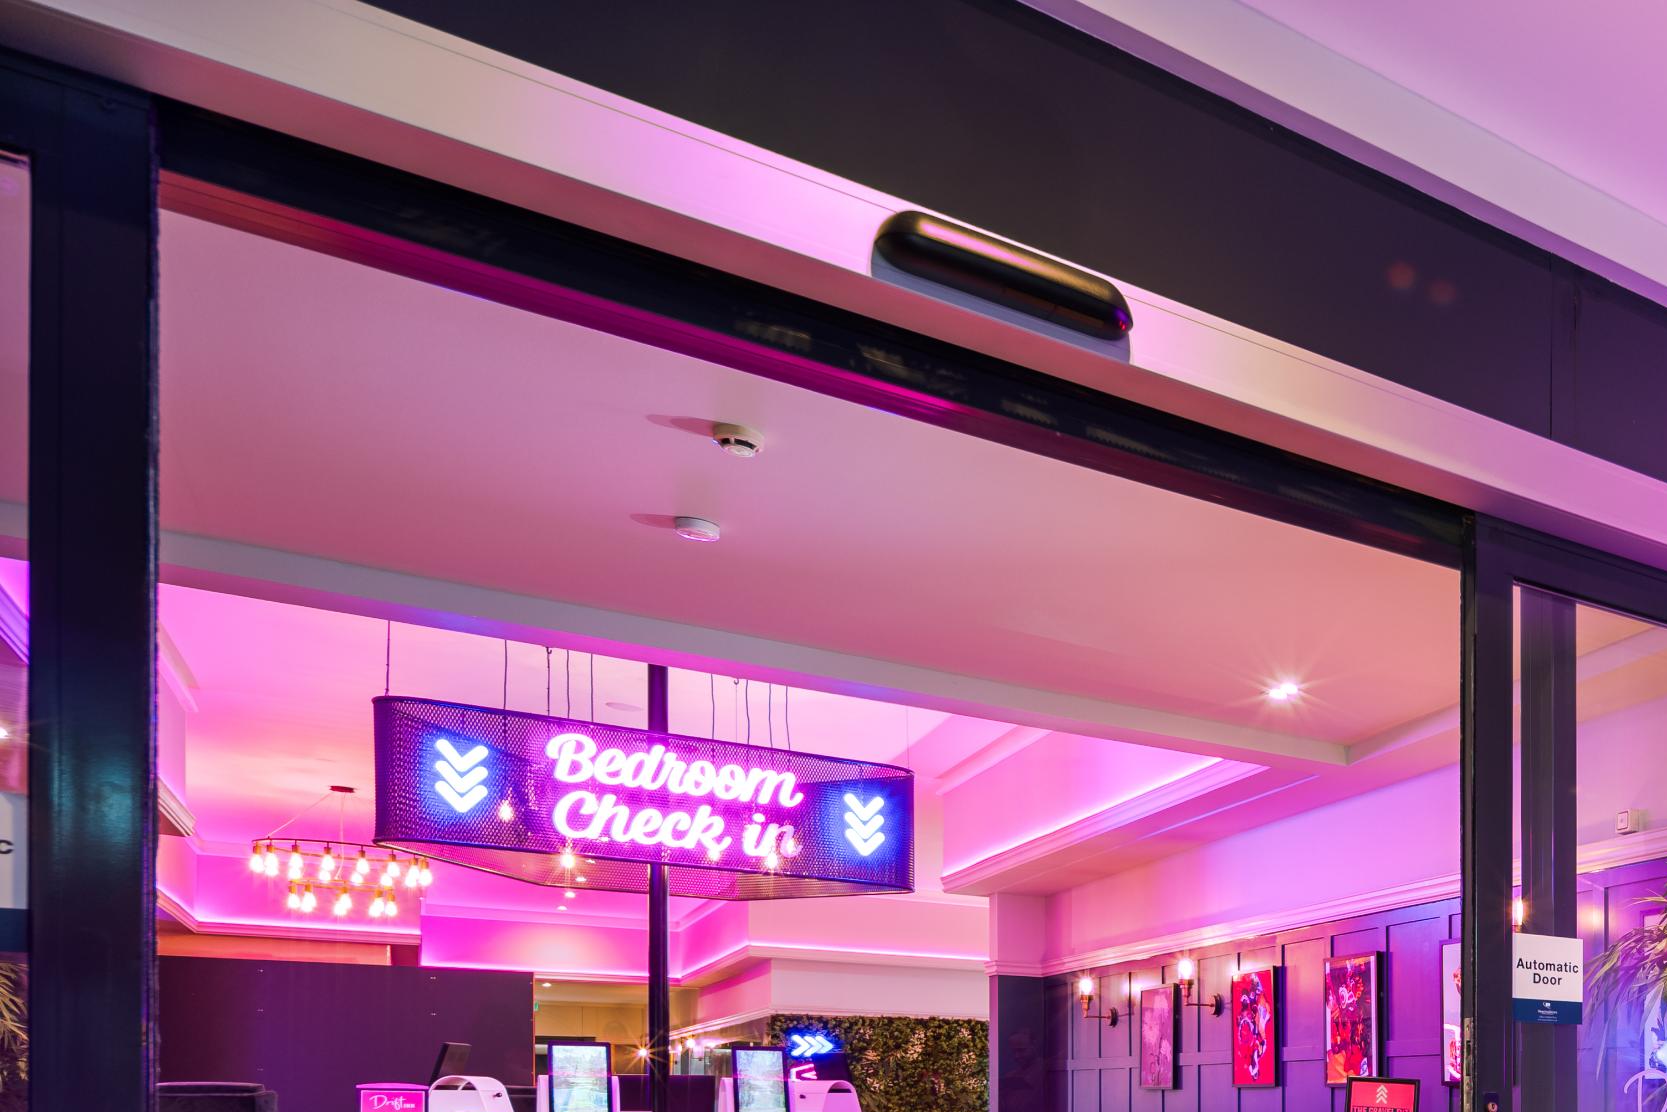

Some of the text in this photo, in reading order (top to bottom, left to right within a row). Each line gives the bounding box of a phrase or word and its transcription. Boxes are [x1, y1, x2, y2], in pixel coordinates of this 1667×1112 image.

[545, 732, 804, 807] Bedroom
[553, 790, 803, 858] Check in
[1516, 957, 1579, 974] Automatic
[1533, 972, 1562, 986] Door
[369, 1094, 406, 1111] Drift
